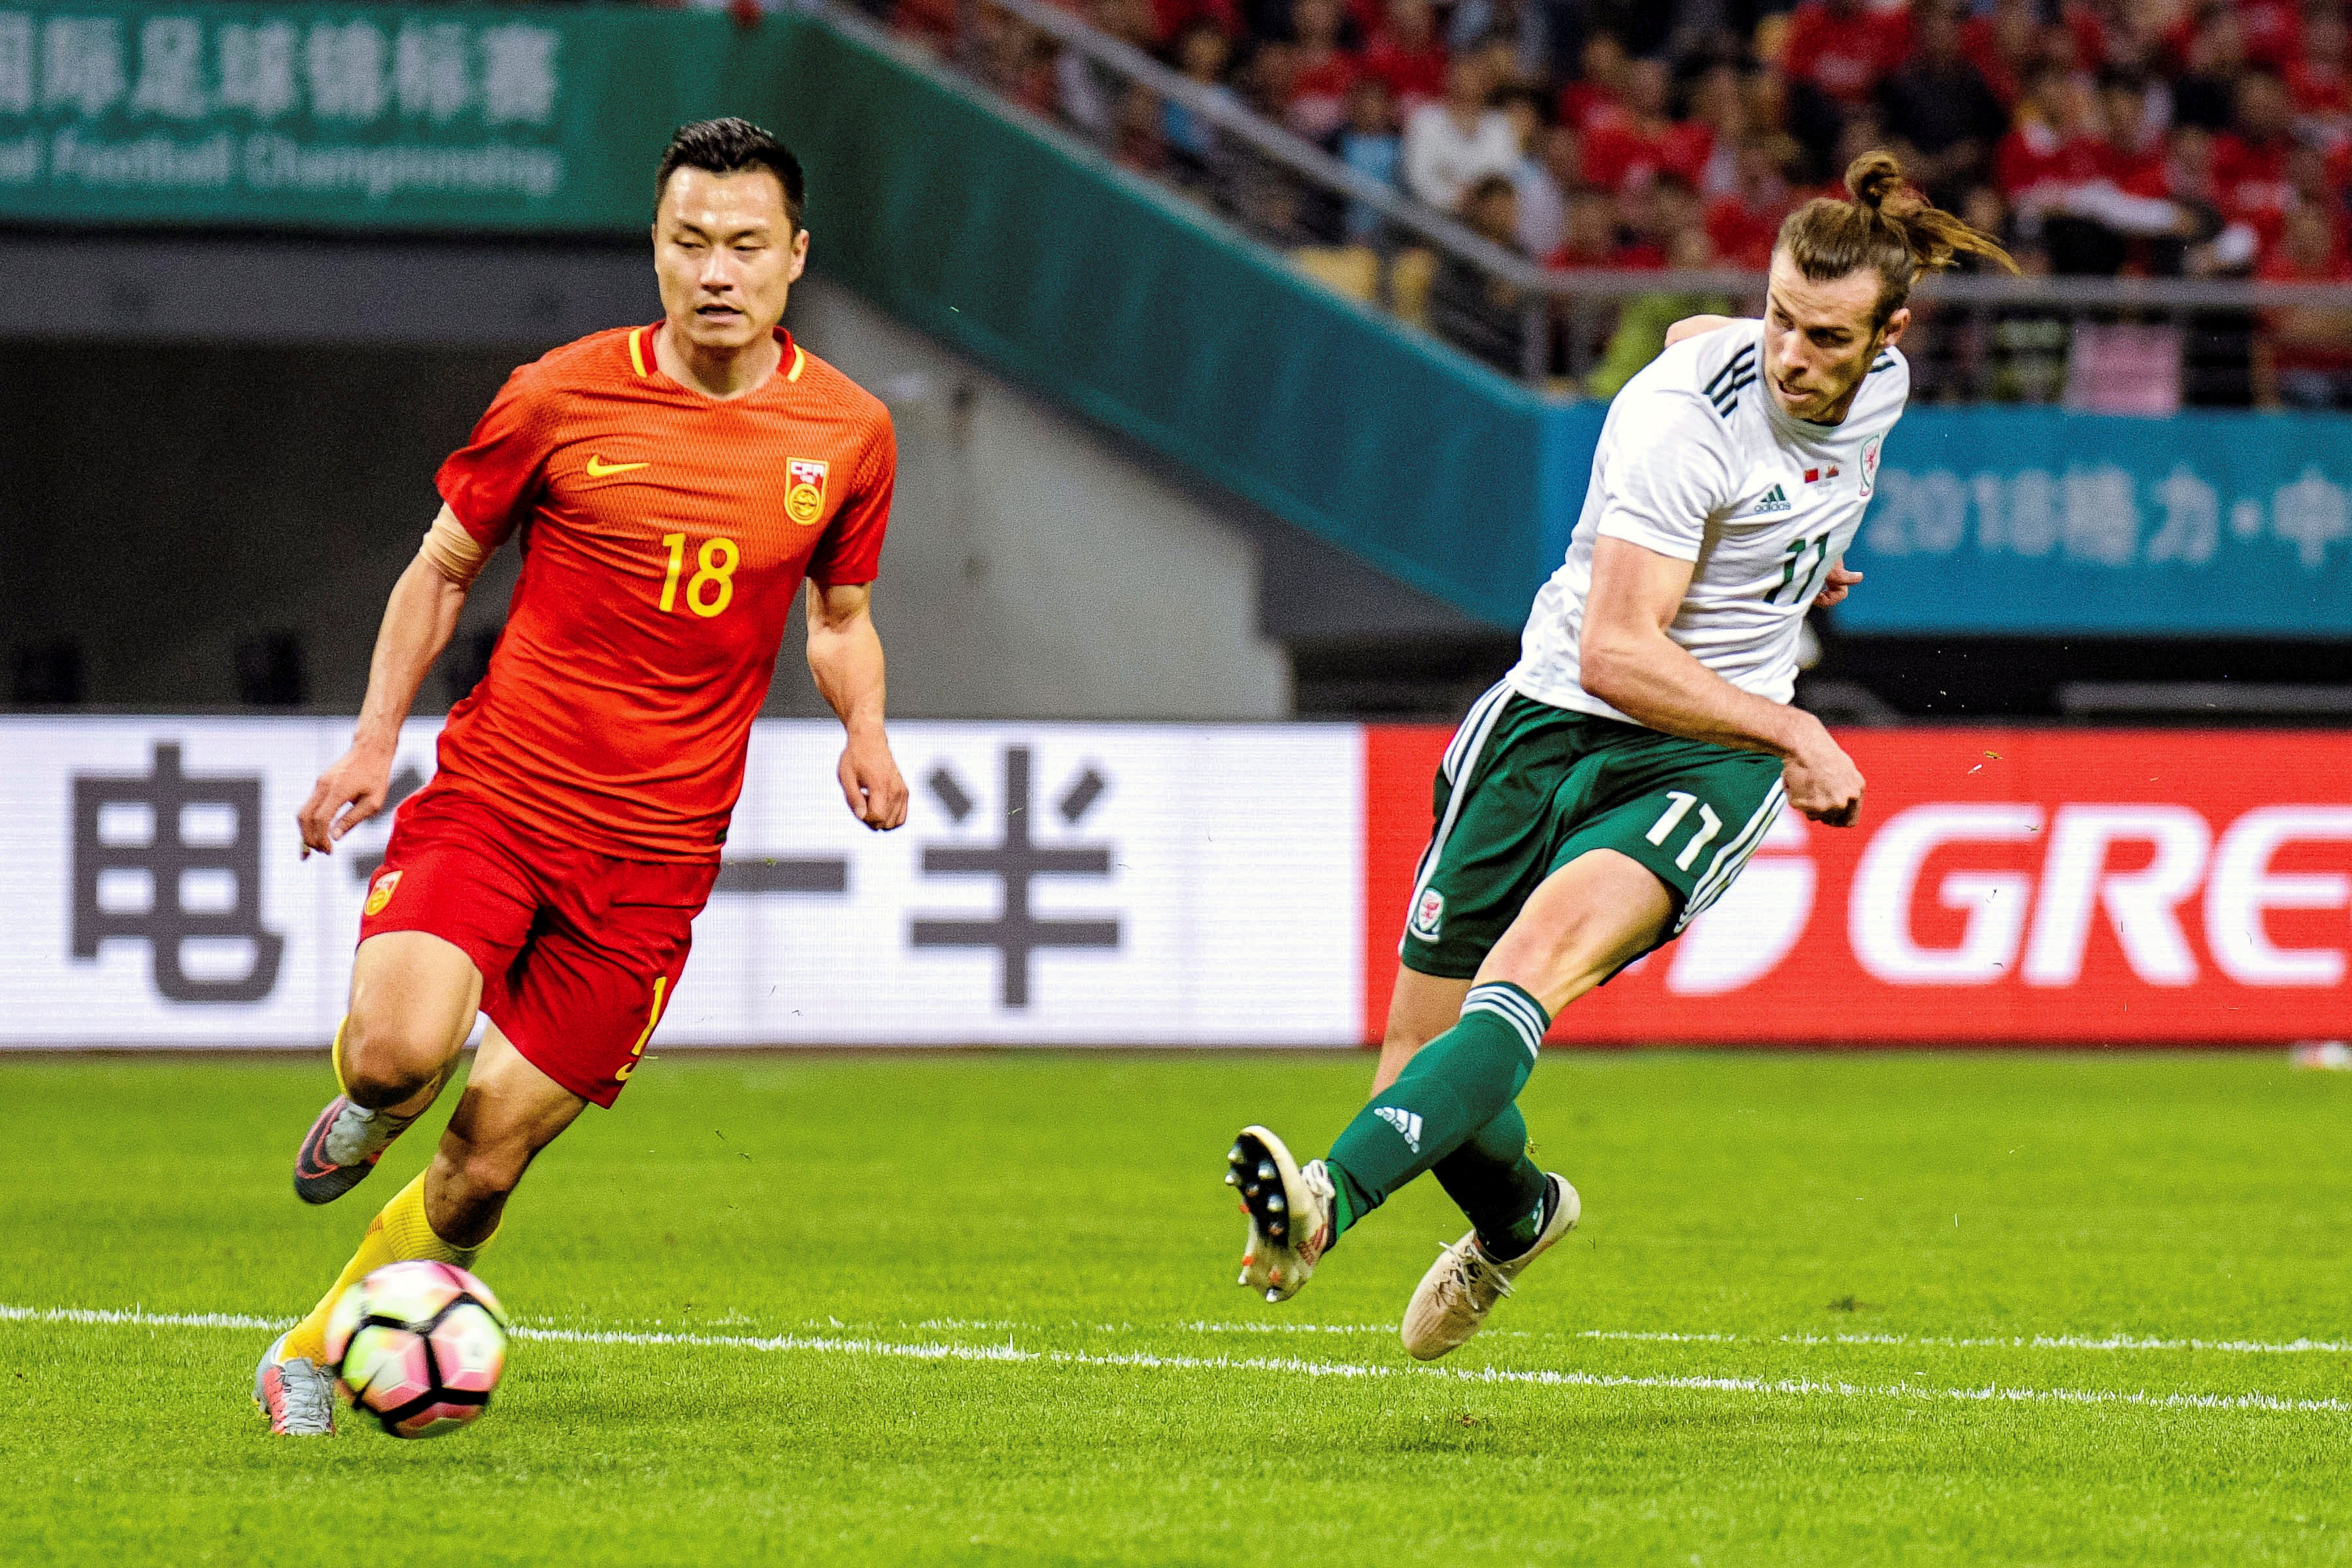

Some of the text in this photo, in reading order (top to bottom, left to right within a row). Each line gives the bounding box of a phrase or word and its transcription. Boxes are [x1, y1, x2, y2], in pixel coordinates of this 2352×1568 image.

[52, 131, 230, 186] Football
[245, 133, 565, 199] Championship
[1754, 501, 1792, 512] adidas
[658, 533, 740, 618] 18
[1763, 530, 1830, 605] 11
[1645, 790, 1723, 873] 11
[69, 739, 1120, 1009] 电一半
[1846, 803, 2352, 989] GRE
